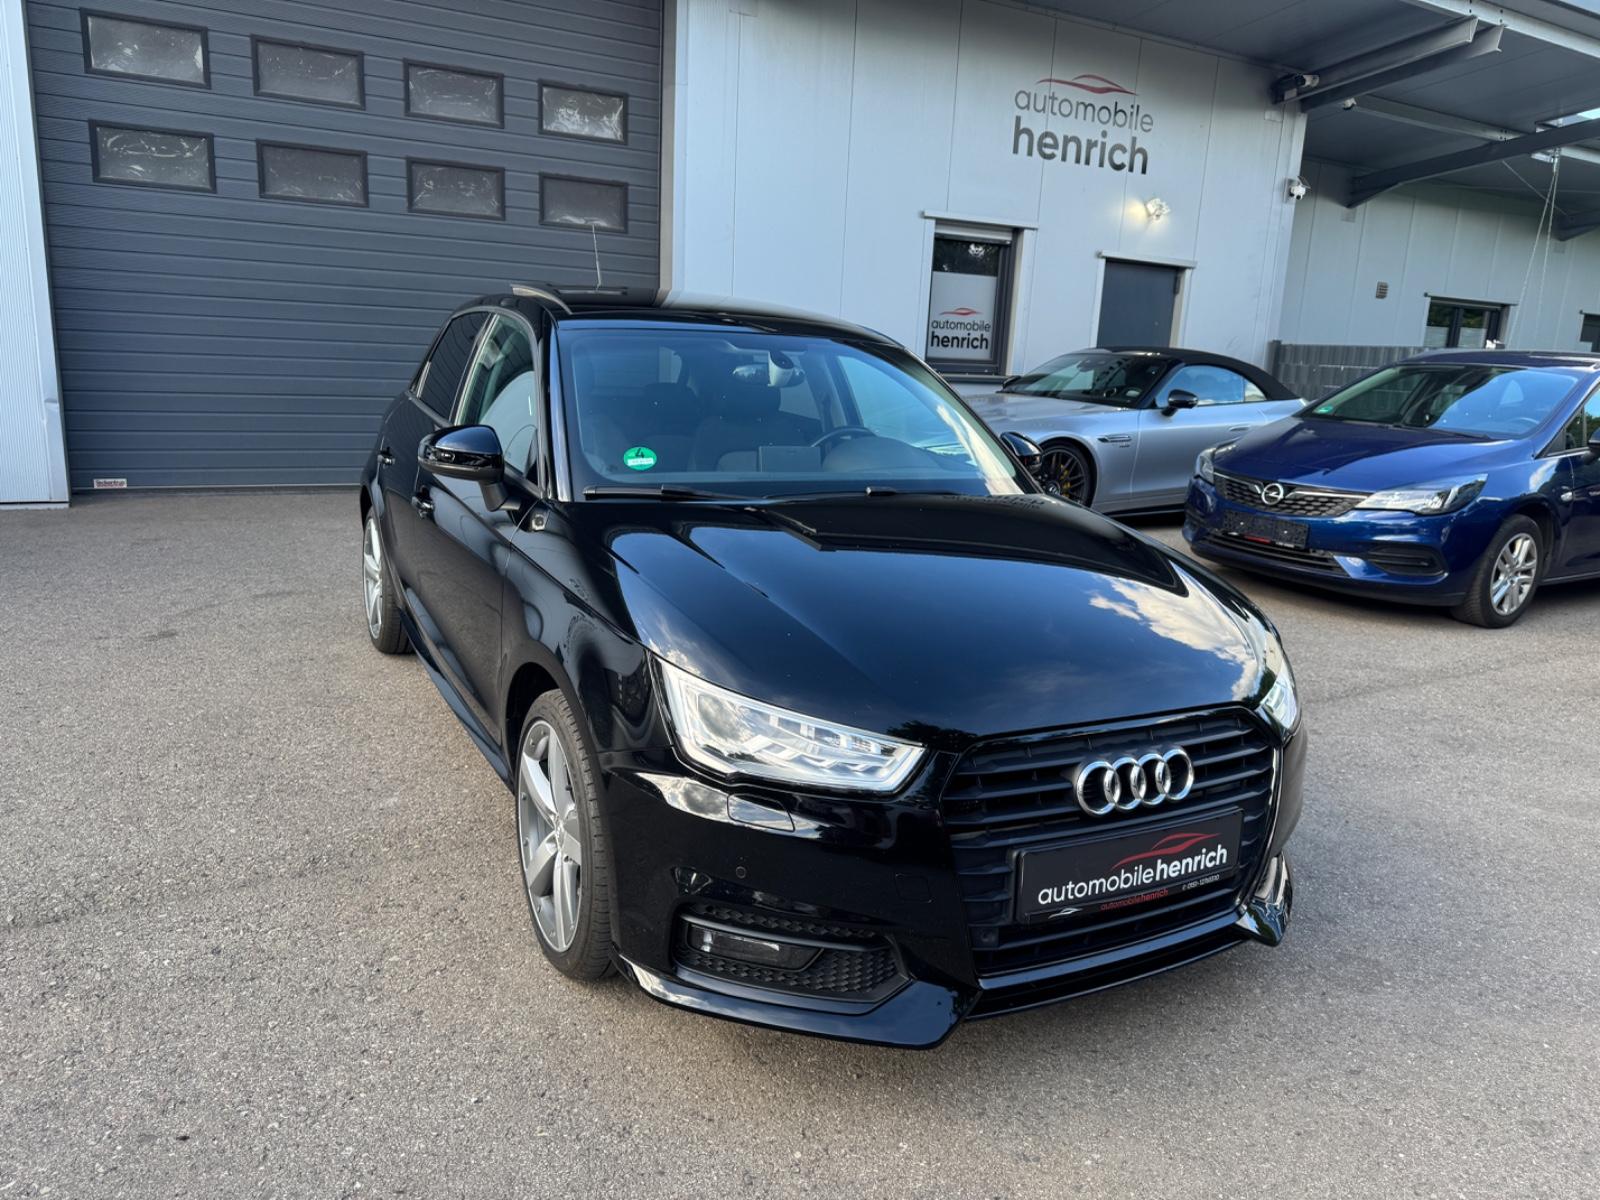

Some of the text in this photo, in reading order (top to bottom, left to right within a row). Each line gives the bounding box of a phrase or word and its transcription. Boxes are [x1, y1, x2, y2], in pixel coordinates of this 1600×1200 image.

[1014, 90, 1154, 133] automobile
[1012, 115, 1148, 175] henrich
[931, 320, 991, 332] automobile
[930, 331, 989, 349] henrich
[635, 447, 645, 459] 4
